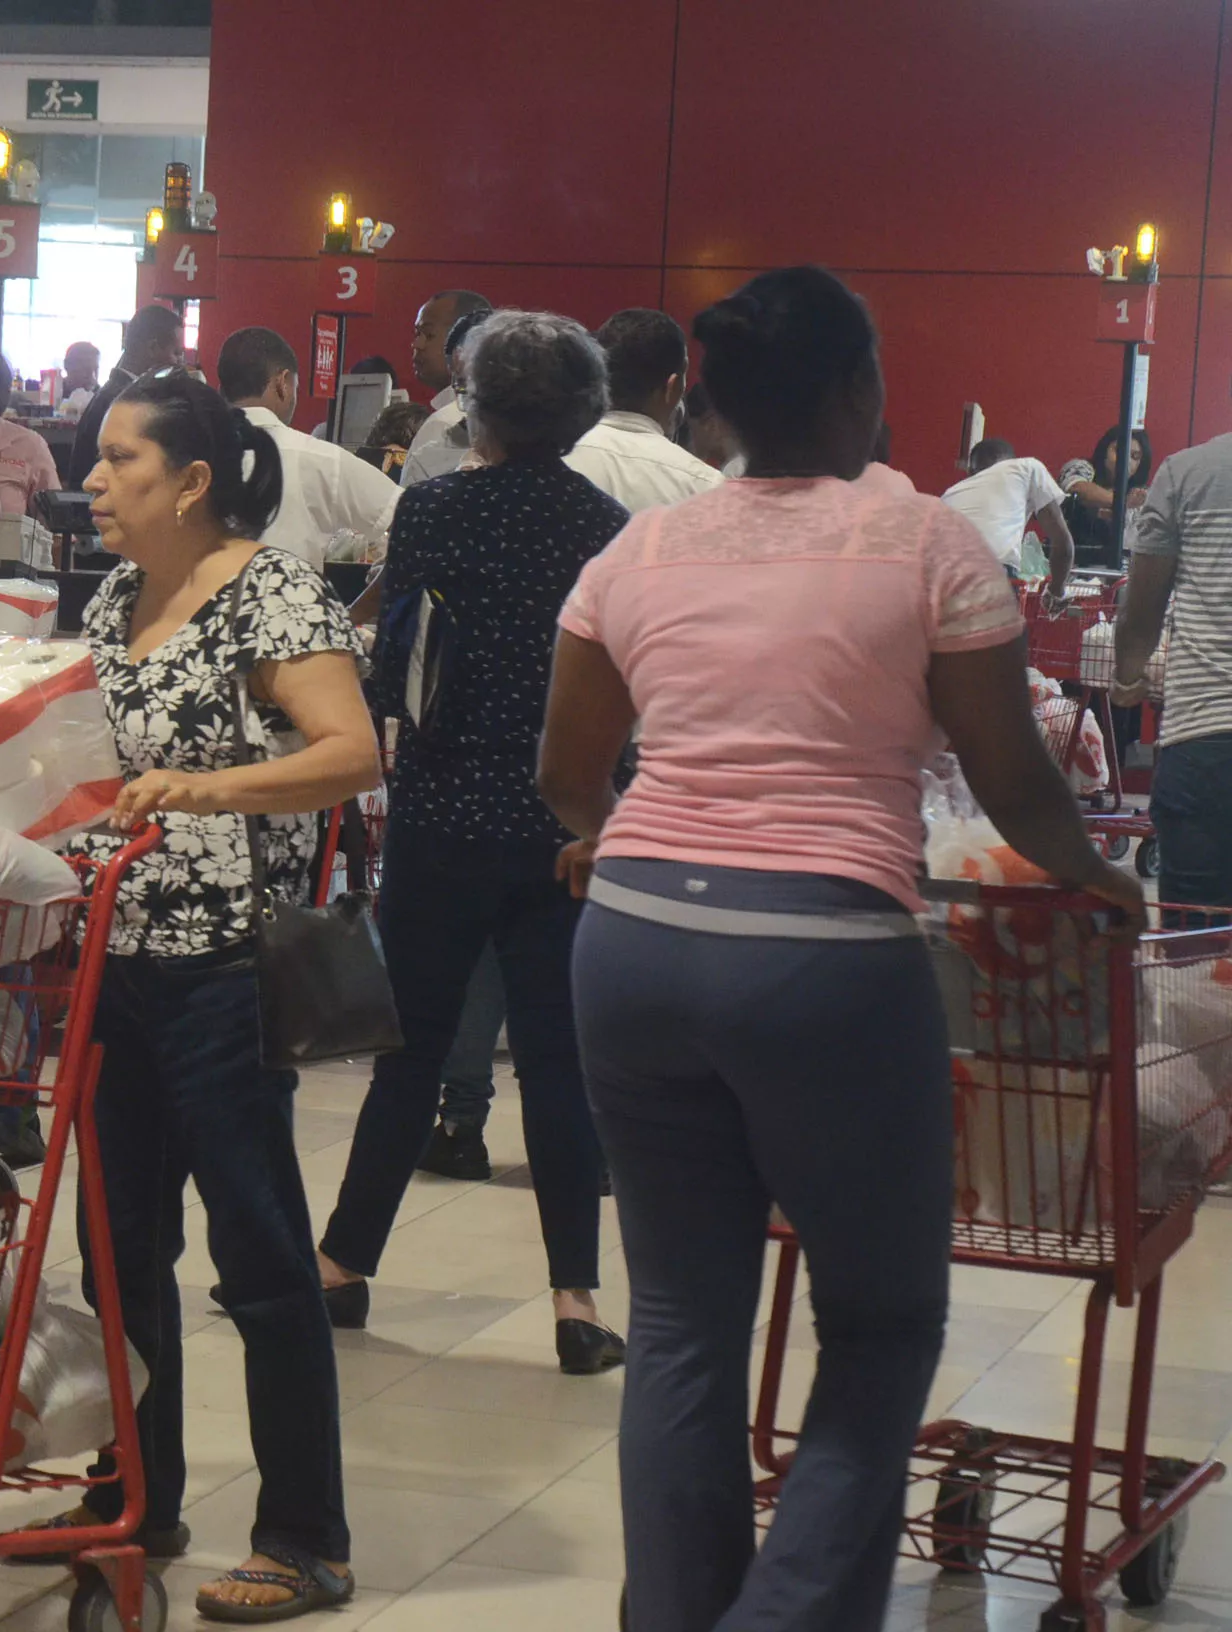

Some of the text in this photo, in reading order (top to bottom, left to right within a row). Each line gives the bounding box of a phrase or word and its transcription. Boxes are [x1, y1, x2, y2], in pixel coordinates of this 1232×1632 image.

[173, 244, 198, 281] 4
[336, 266, 358, 299] 3
[1115, 299, 1130, 323] 1
